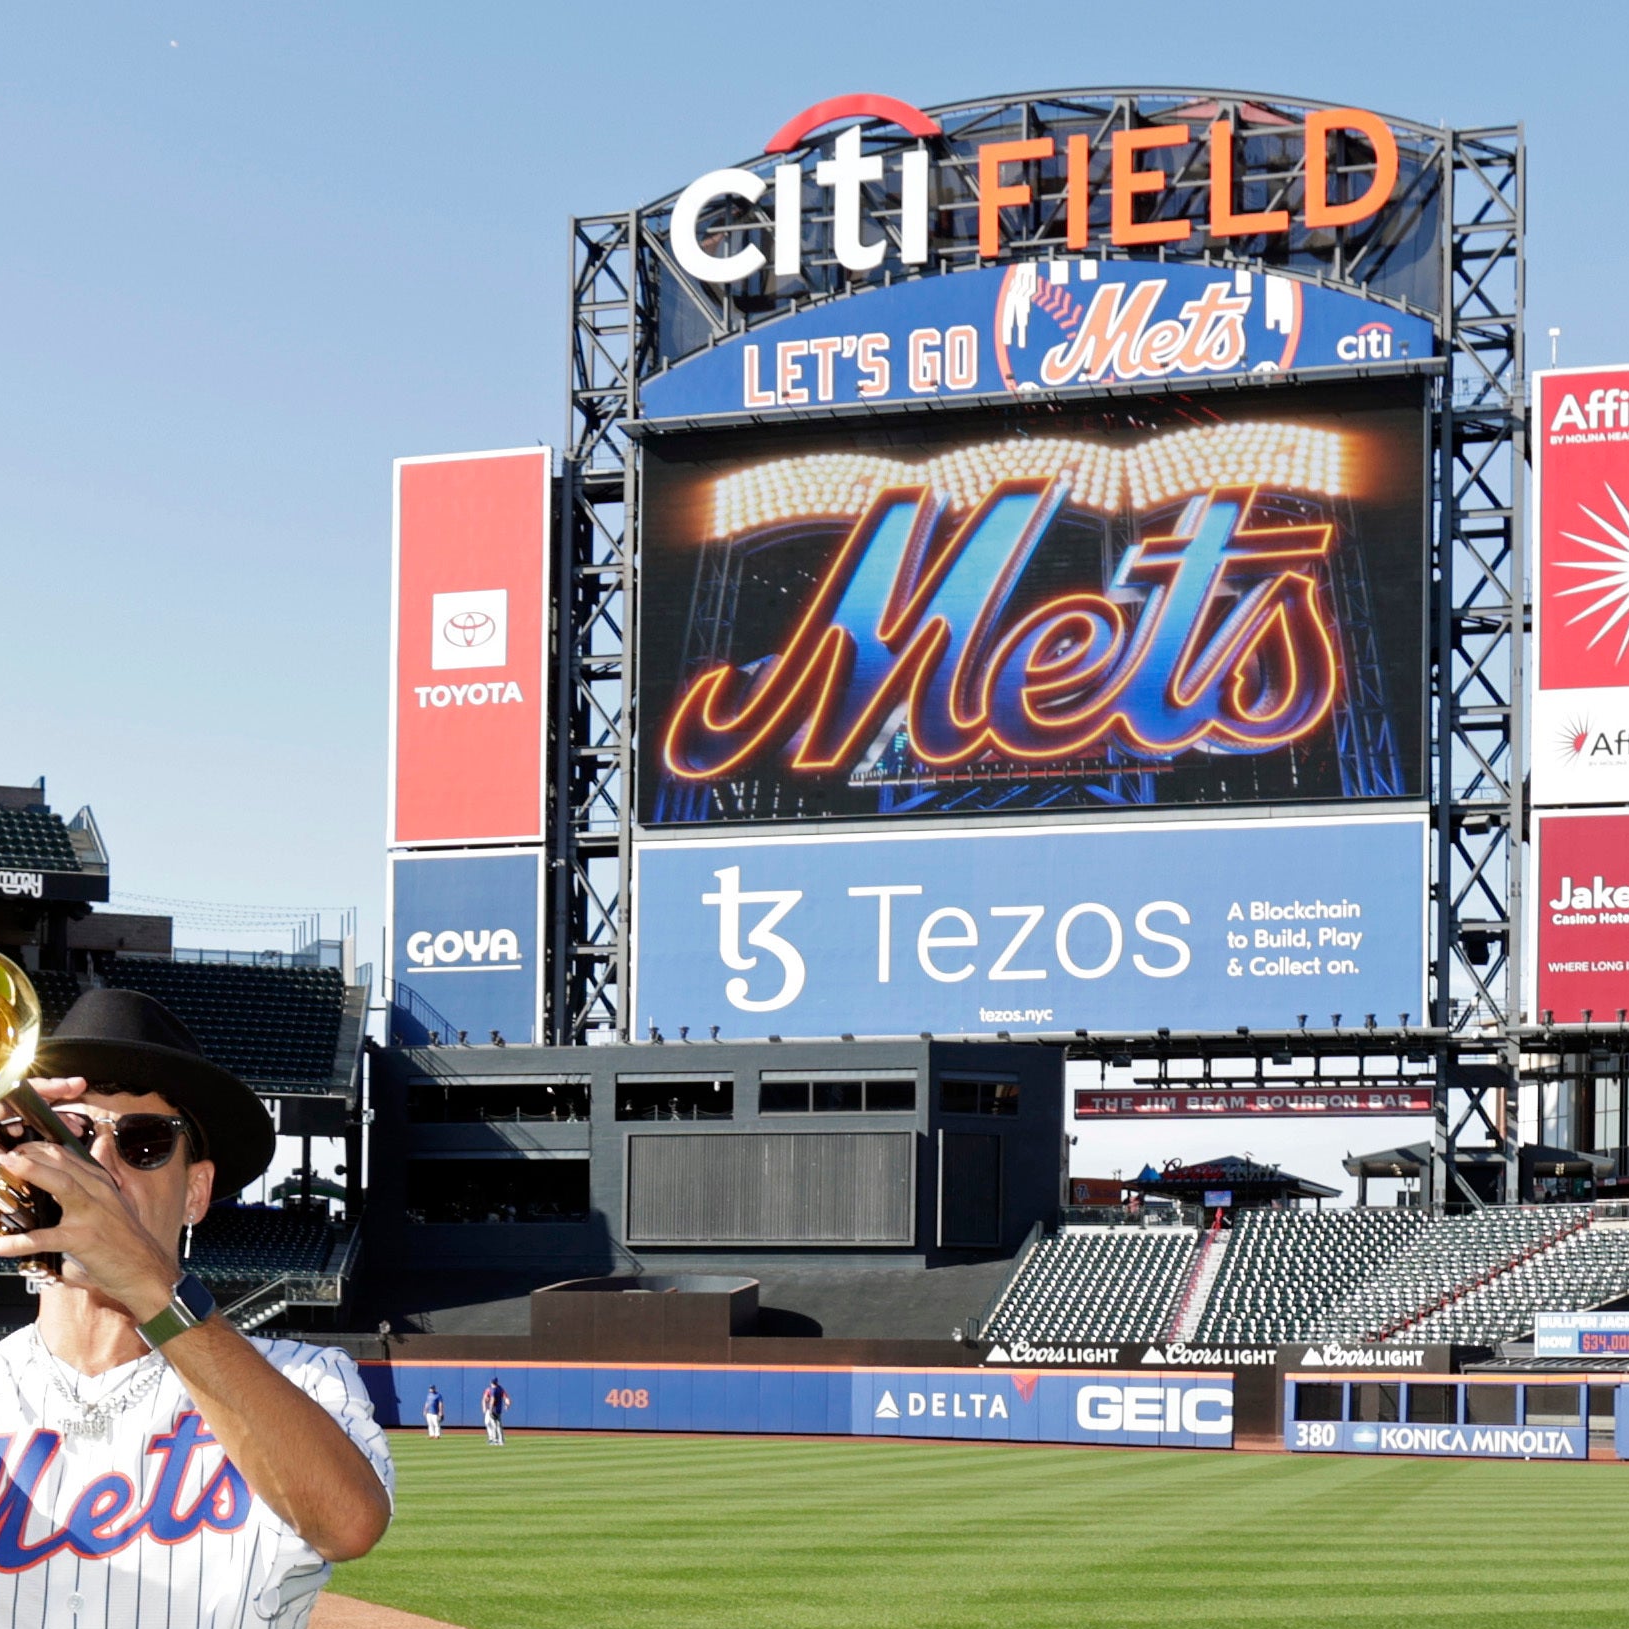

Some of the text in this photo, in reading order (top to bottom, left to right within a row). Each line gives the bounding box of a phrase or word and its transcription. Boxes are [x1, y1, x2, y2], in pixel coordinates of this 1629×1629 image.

[670, 107, 1399, 283] citi FIELD
[1041, 279, 1251, 388] Mets
[1336, 329, 1391, 360] citi
[743, 325, 978, 408] LET'S GO
[1550, 435, 1563, 446] BY
[1566, 432, 1605, 444] MOLINA
[664, 474, 1338, 779] Mets
[415, 681, 523, 709] TOYOTA
[1227, 899, 1361, 920] A Blockchain
[1552, 913, 1596, 925] Casino
[406, 929, 518, 964] GOYA
[848, 885, 1192, 985] Tezos
[1227, 927, 1362, 950] to Build, Play
[1227, 956, 1359, 977] & Collect on.
[1548, 962, 1589, 972] WHERE
[1591, 961, 1624, 972] LONG
[979, 1006, 1053, 1026] tezos.nyc
[1092, 1093, 1412, 1110] THE JIM BEAM BOURBON BAR
[1539, 1316, 1597, 1328] BULLPEN
[1009, 1341, 1119, 1364] Coors LIGHT
[1539, 1335, 1572, 1348] NOW
[1165, 1342, 1277, 1365] Coors LIGHT
[1321, 1342, 1424, 1366] Coors LIGHT
[604, 1388, 649, 1409] 408
[908, 1393, 1009, 1419] DELTA
[1296, 1423, 1336, 1447] 380
[1380, 1429, 1573, 1454] KONICA MINOLTA
